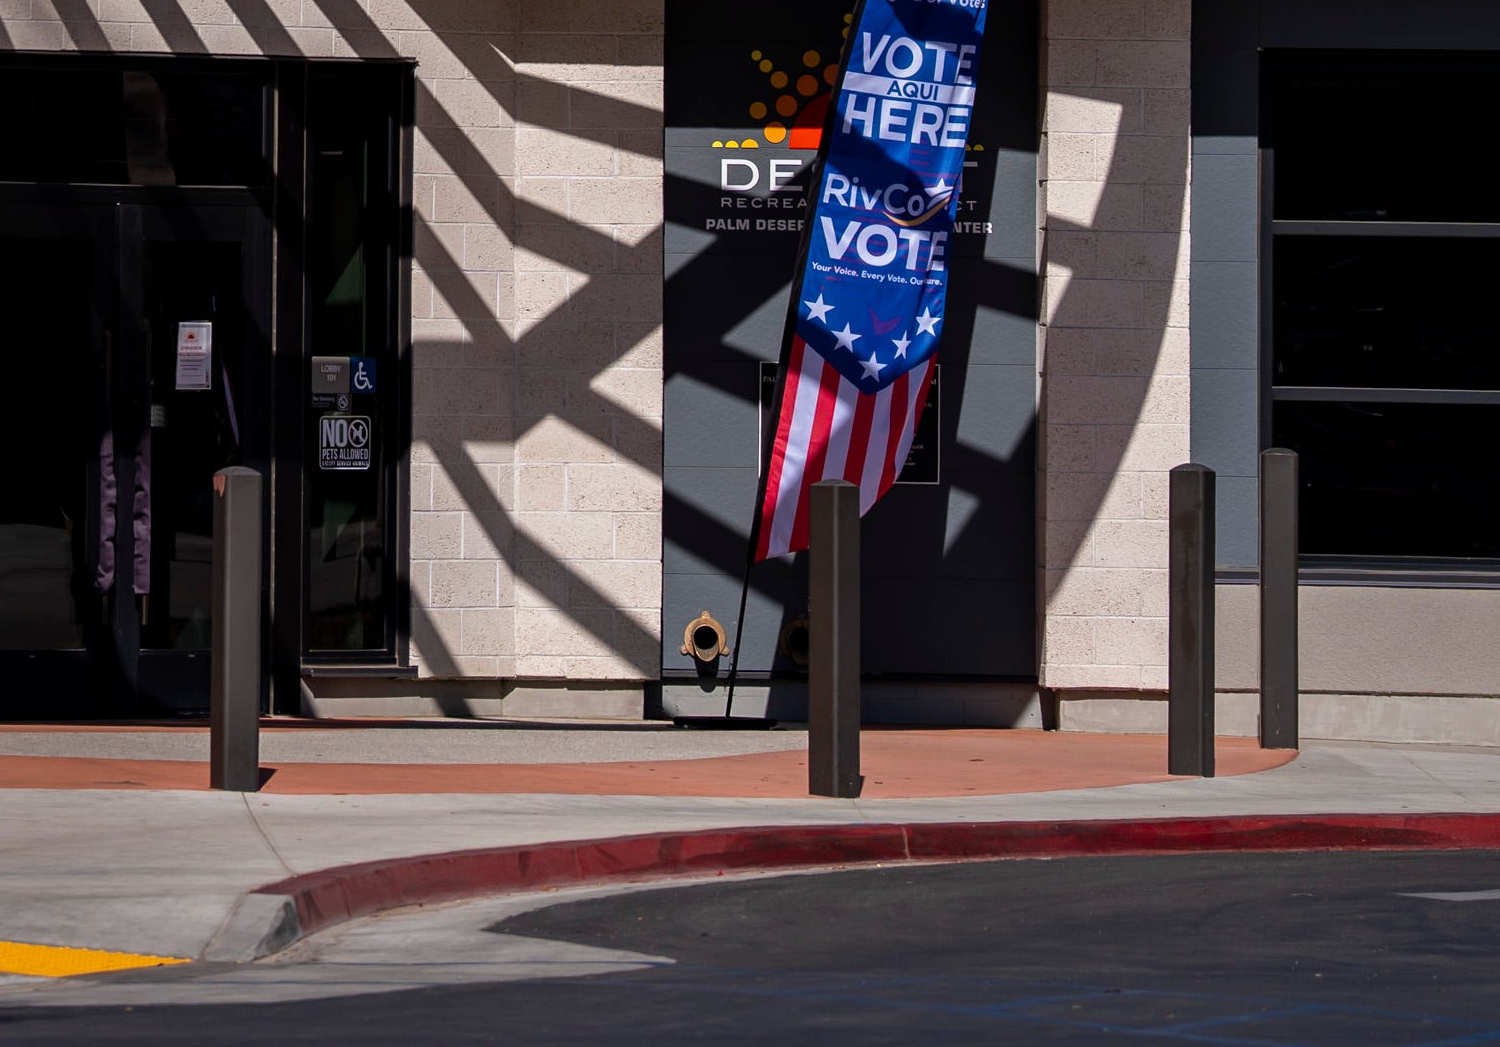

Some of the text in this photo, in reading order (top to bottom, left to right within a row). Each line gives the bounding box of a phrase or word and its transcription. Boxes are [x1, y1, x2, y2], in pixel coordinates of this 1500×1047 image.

[862, 31, 977, 85] VOTE
[887, 80, 939, 101] AQUI
[842, 93, 970, 149] HERE
[720, 197, 808, 209] RECREA
[822, 172, 926, 217] RivCo
[705, 218, 750, 231] PALM
[954, 221, 994, 234] NTER
[820, 215, 949, 272] VOTE
[811, 261, 832, 273] Your
[833, 265, 859, 277] Voice.
[861, 270, 886, 283] Every
[887, 273, 908, 284] Vote.
[320, 364, 342, 373] LOBBY
[326, 374, 337, 382] 101
[322, 419, 348, 448] NO
[322, 448, 369, 460] PETS ALLOWED
